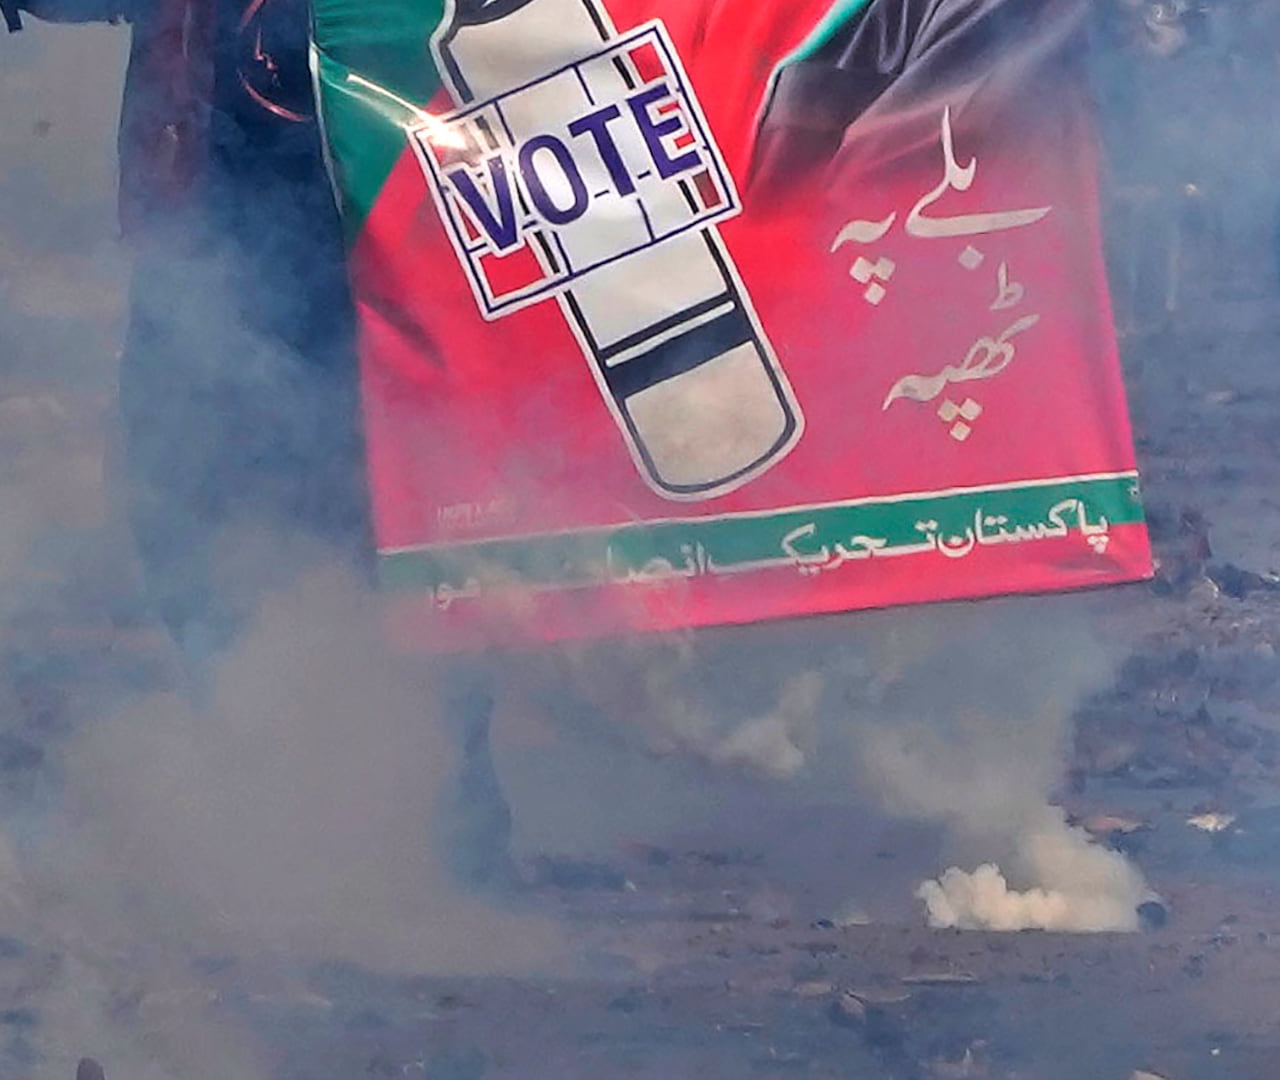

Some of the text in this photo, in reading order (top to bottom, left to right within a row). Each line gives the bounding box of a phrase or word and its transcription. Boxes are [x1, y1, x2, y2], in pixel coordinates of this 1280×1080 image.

[446, 80, 705, 254] VOTE
[830, 104, 1053, 306] بلے پہ
[881, 261, 1041, 441] ٹھپہ
[713, 517, 936, 576] تحریک
[933, 498, 1112, 559] پاکستان
